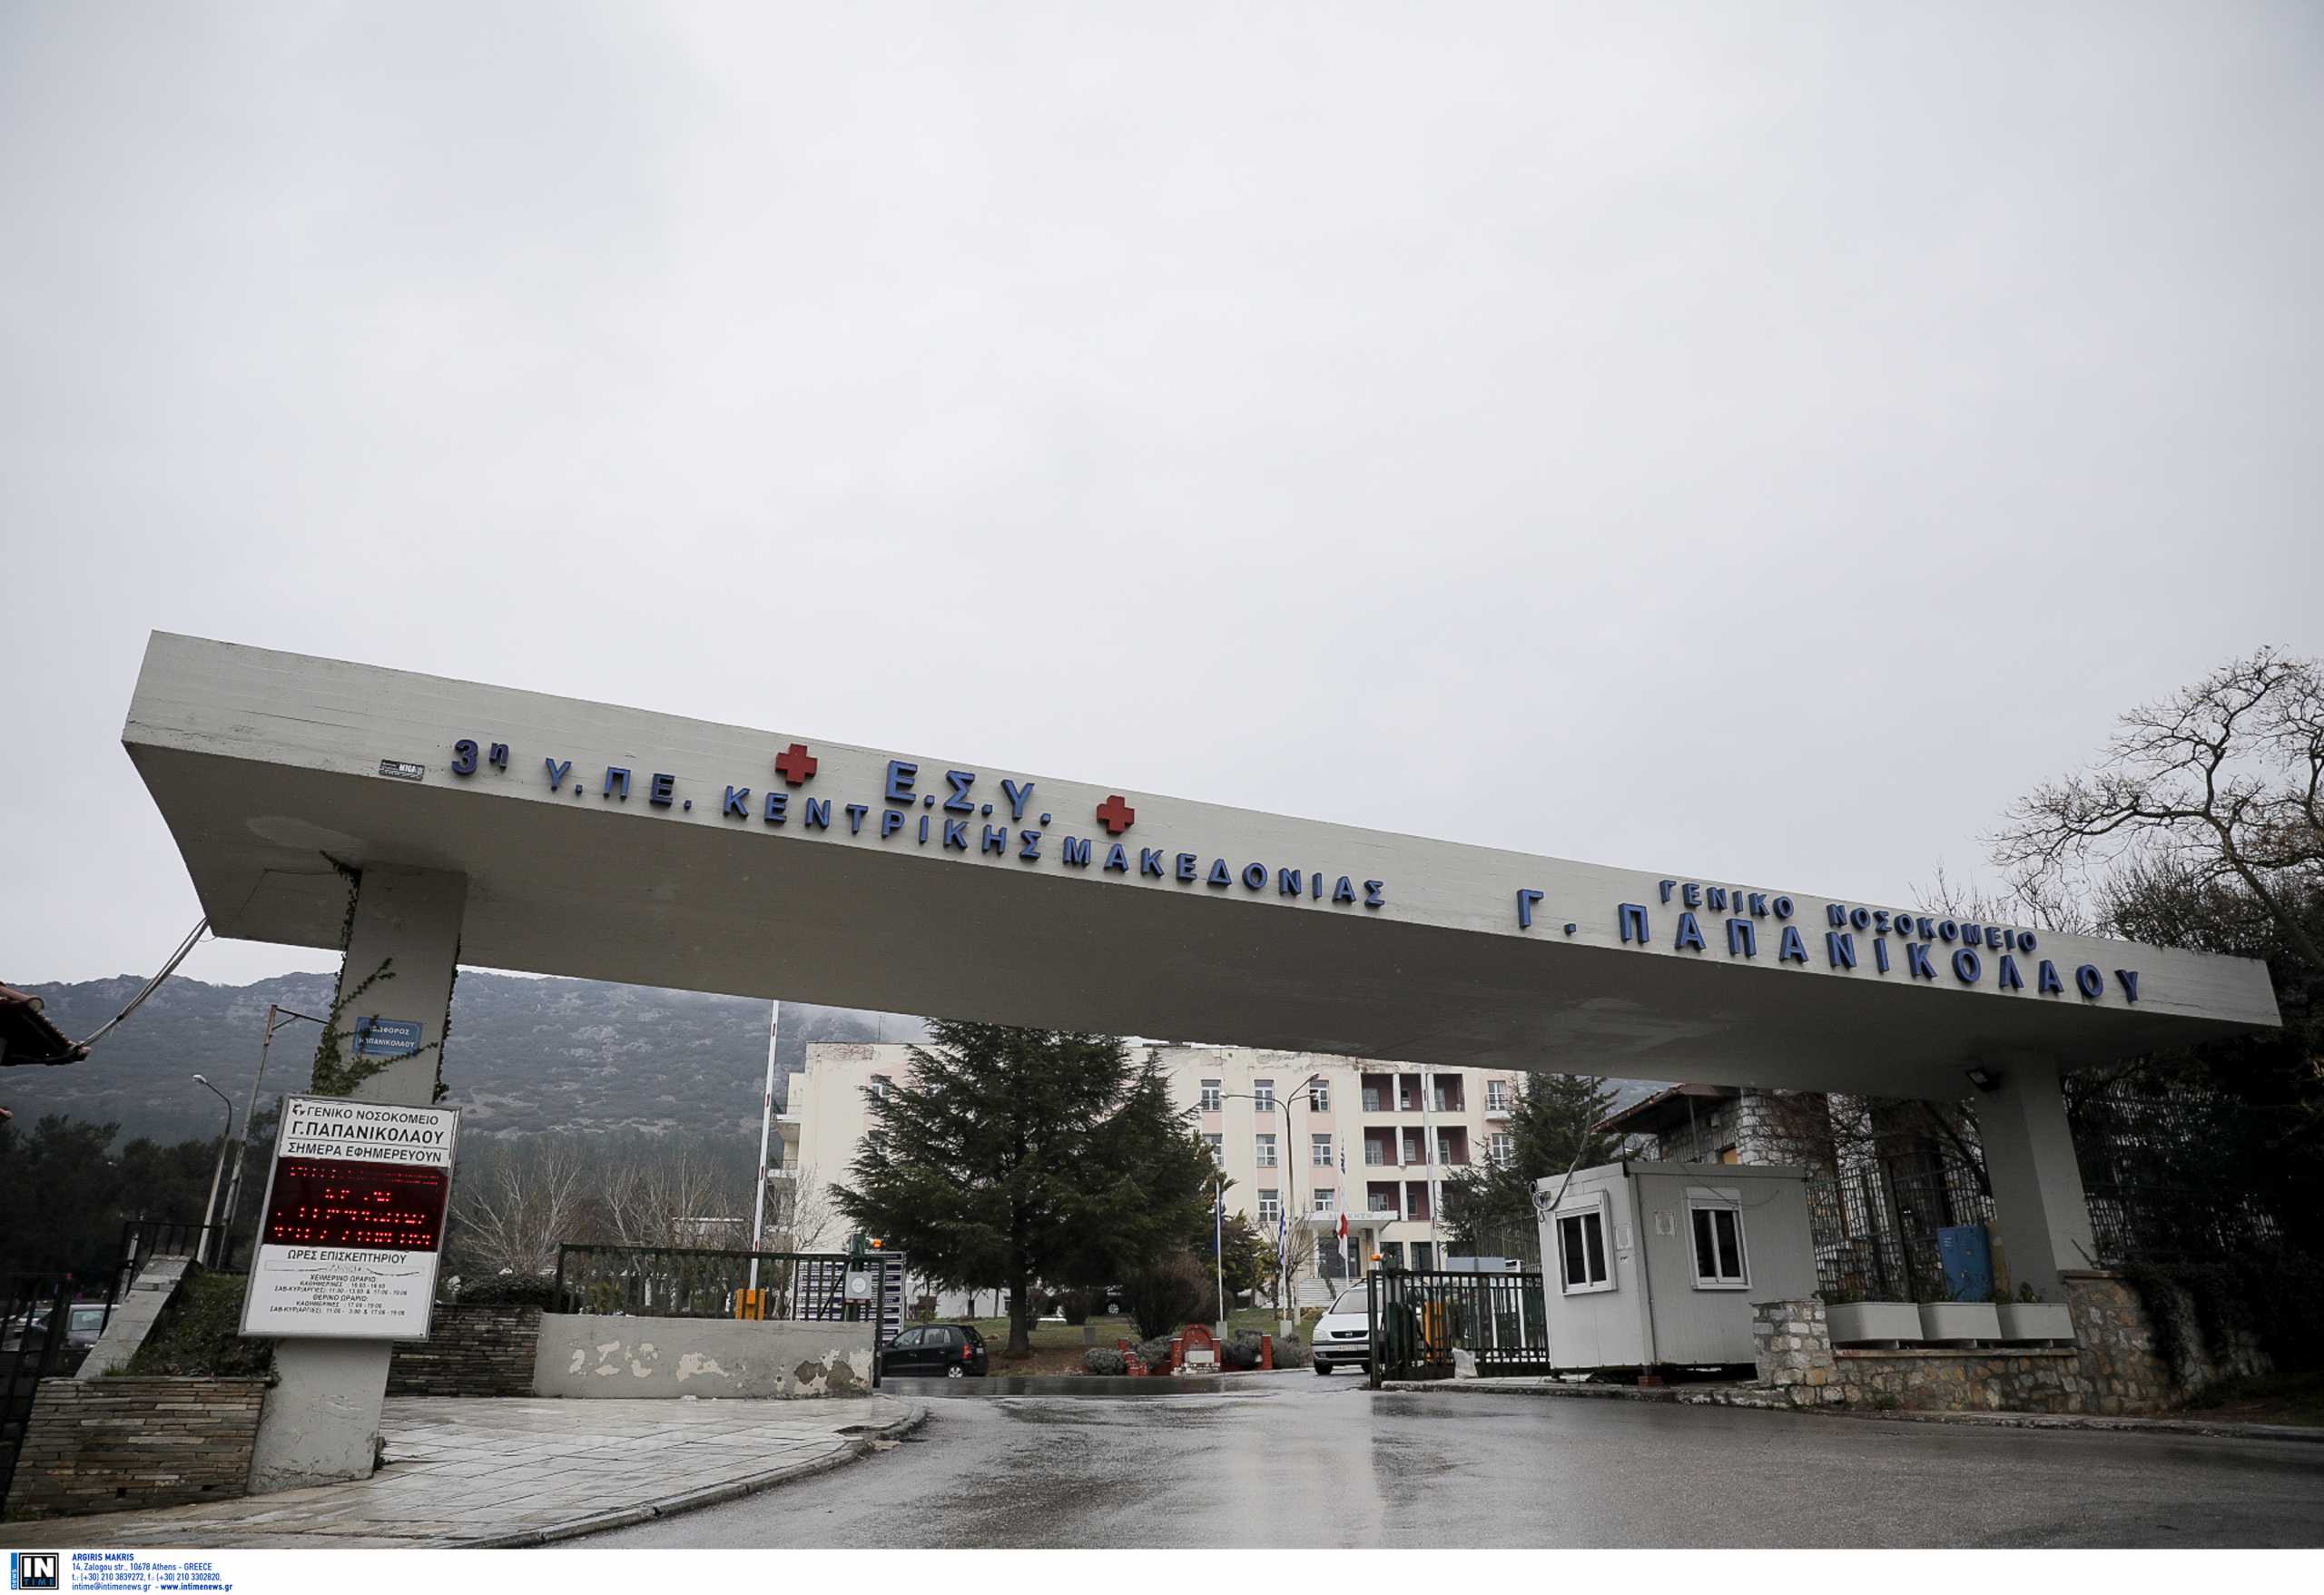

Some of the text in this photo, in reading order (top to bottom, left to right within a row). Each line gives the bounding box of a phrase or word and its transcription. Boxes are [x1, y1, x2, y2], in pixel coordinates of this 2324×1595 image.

[885, 759, 1051, 826] Ε.Σ.Υ.
[451, 739, 509, 775] 3η
[723, 784, 1041, 860] ΚΕΝΤΡΙΚΗΣ
[1063, 836, 1385, 909] ΜΑΚΕΔΟΝΙΑΣ
[1659, 879, 2037, 953] ΓΕΝΙΚΟ ΝΟΣΟΚΟΜΕΙΟ
[1517, 889, 2139, 1003] Γ. ΠΑΠΑΝΙΚΟΛΑΟΥ
[291, 1121, 444, 1145] Γ.ΠΑΠΑΝΙΚΟΛΑΟΥ
[307, 1107, 438, 1126] ΓΕΝΙΚΟ ΝΟΣΟΚΟΜΕΙΟ
[288, 1142, 442, 1163] ΣΗΜΕΡΑ ΕΦΗΜΕΡΕΥΟΥΝ
[287, 1249, 407, 1264] ΩΡΕΣ ΕΠΙΣΚΕΠΤΗΡΙΟΥ
